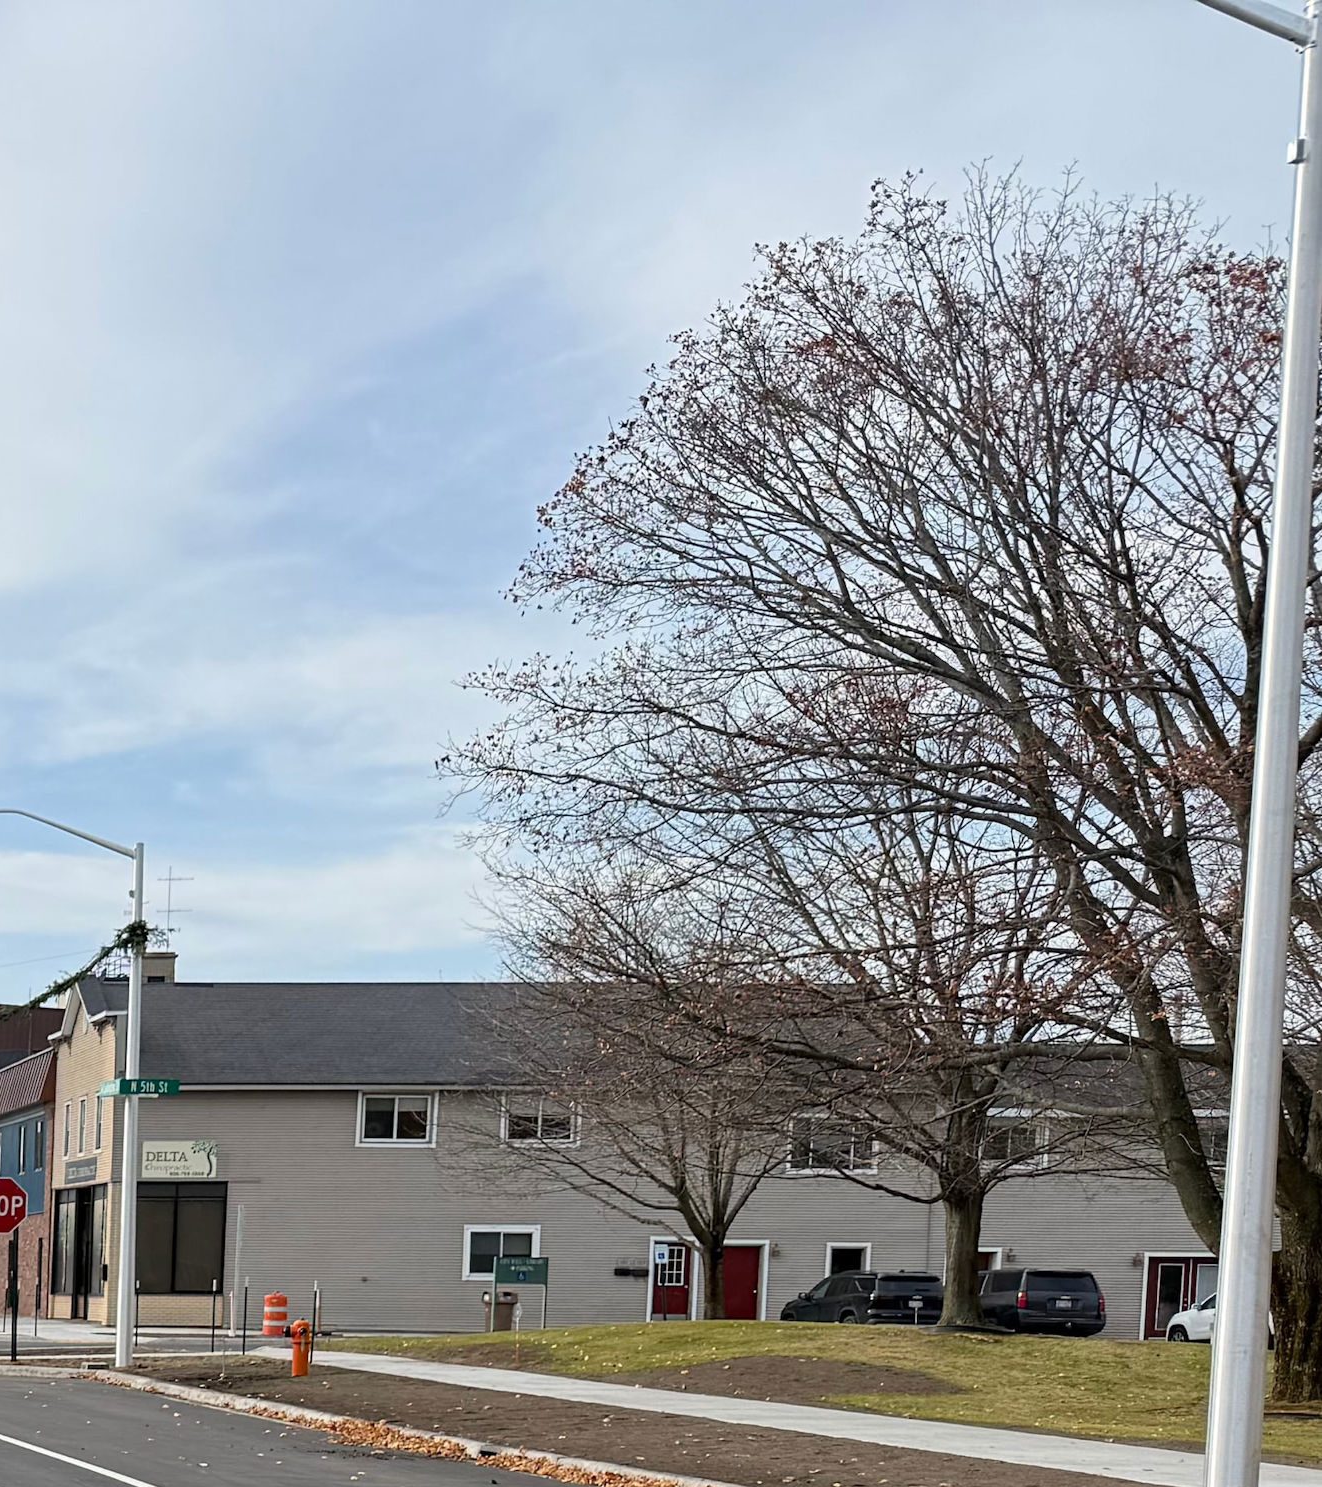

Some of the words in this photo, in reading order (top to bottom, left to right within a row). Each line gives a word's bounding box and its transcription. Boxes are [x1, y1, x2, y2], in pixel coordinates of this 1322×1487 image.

[130, 1081, 137, 1092] N
[140, 1081, 155, 1092] 5th
[158, 1081, 168, 1093] St
[145, 1151, 188, 1162] DELTA
